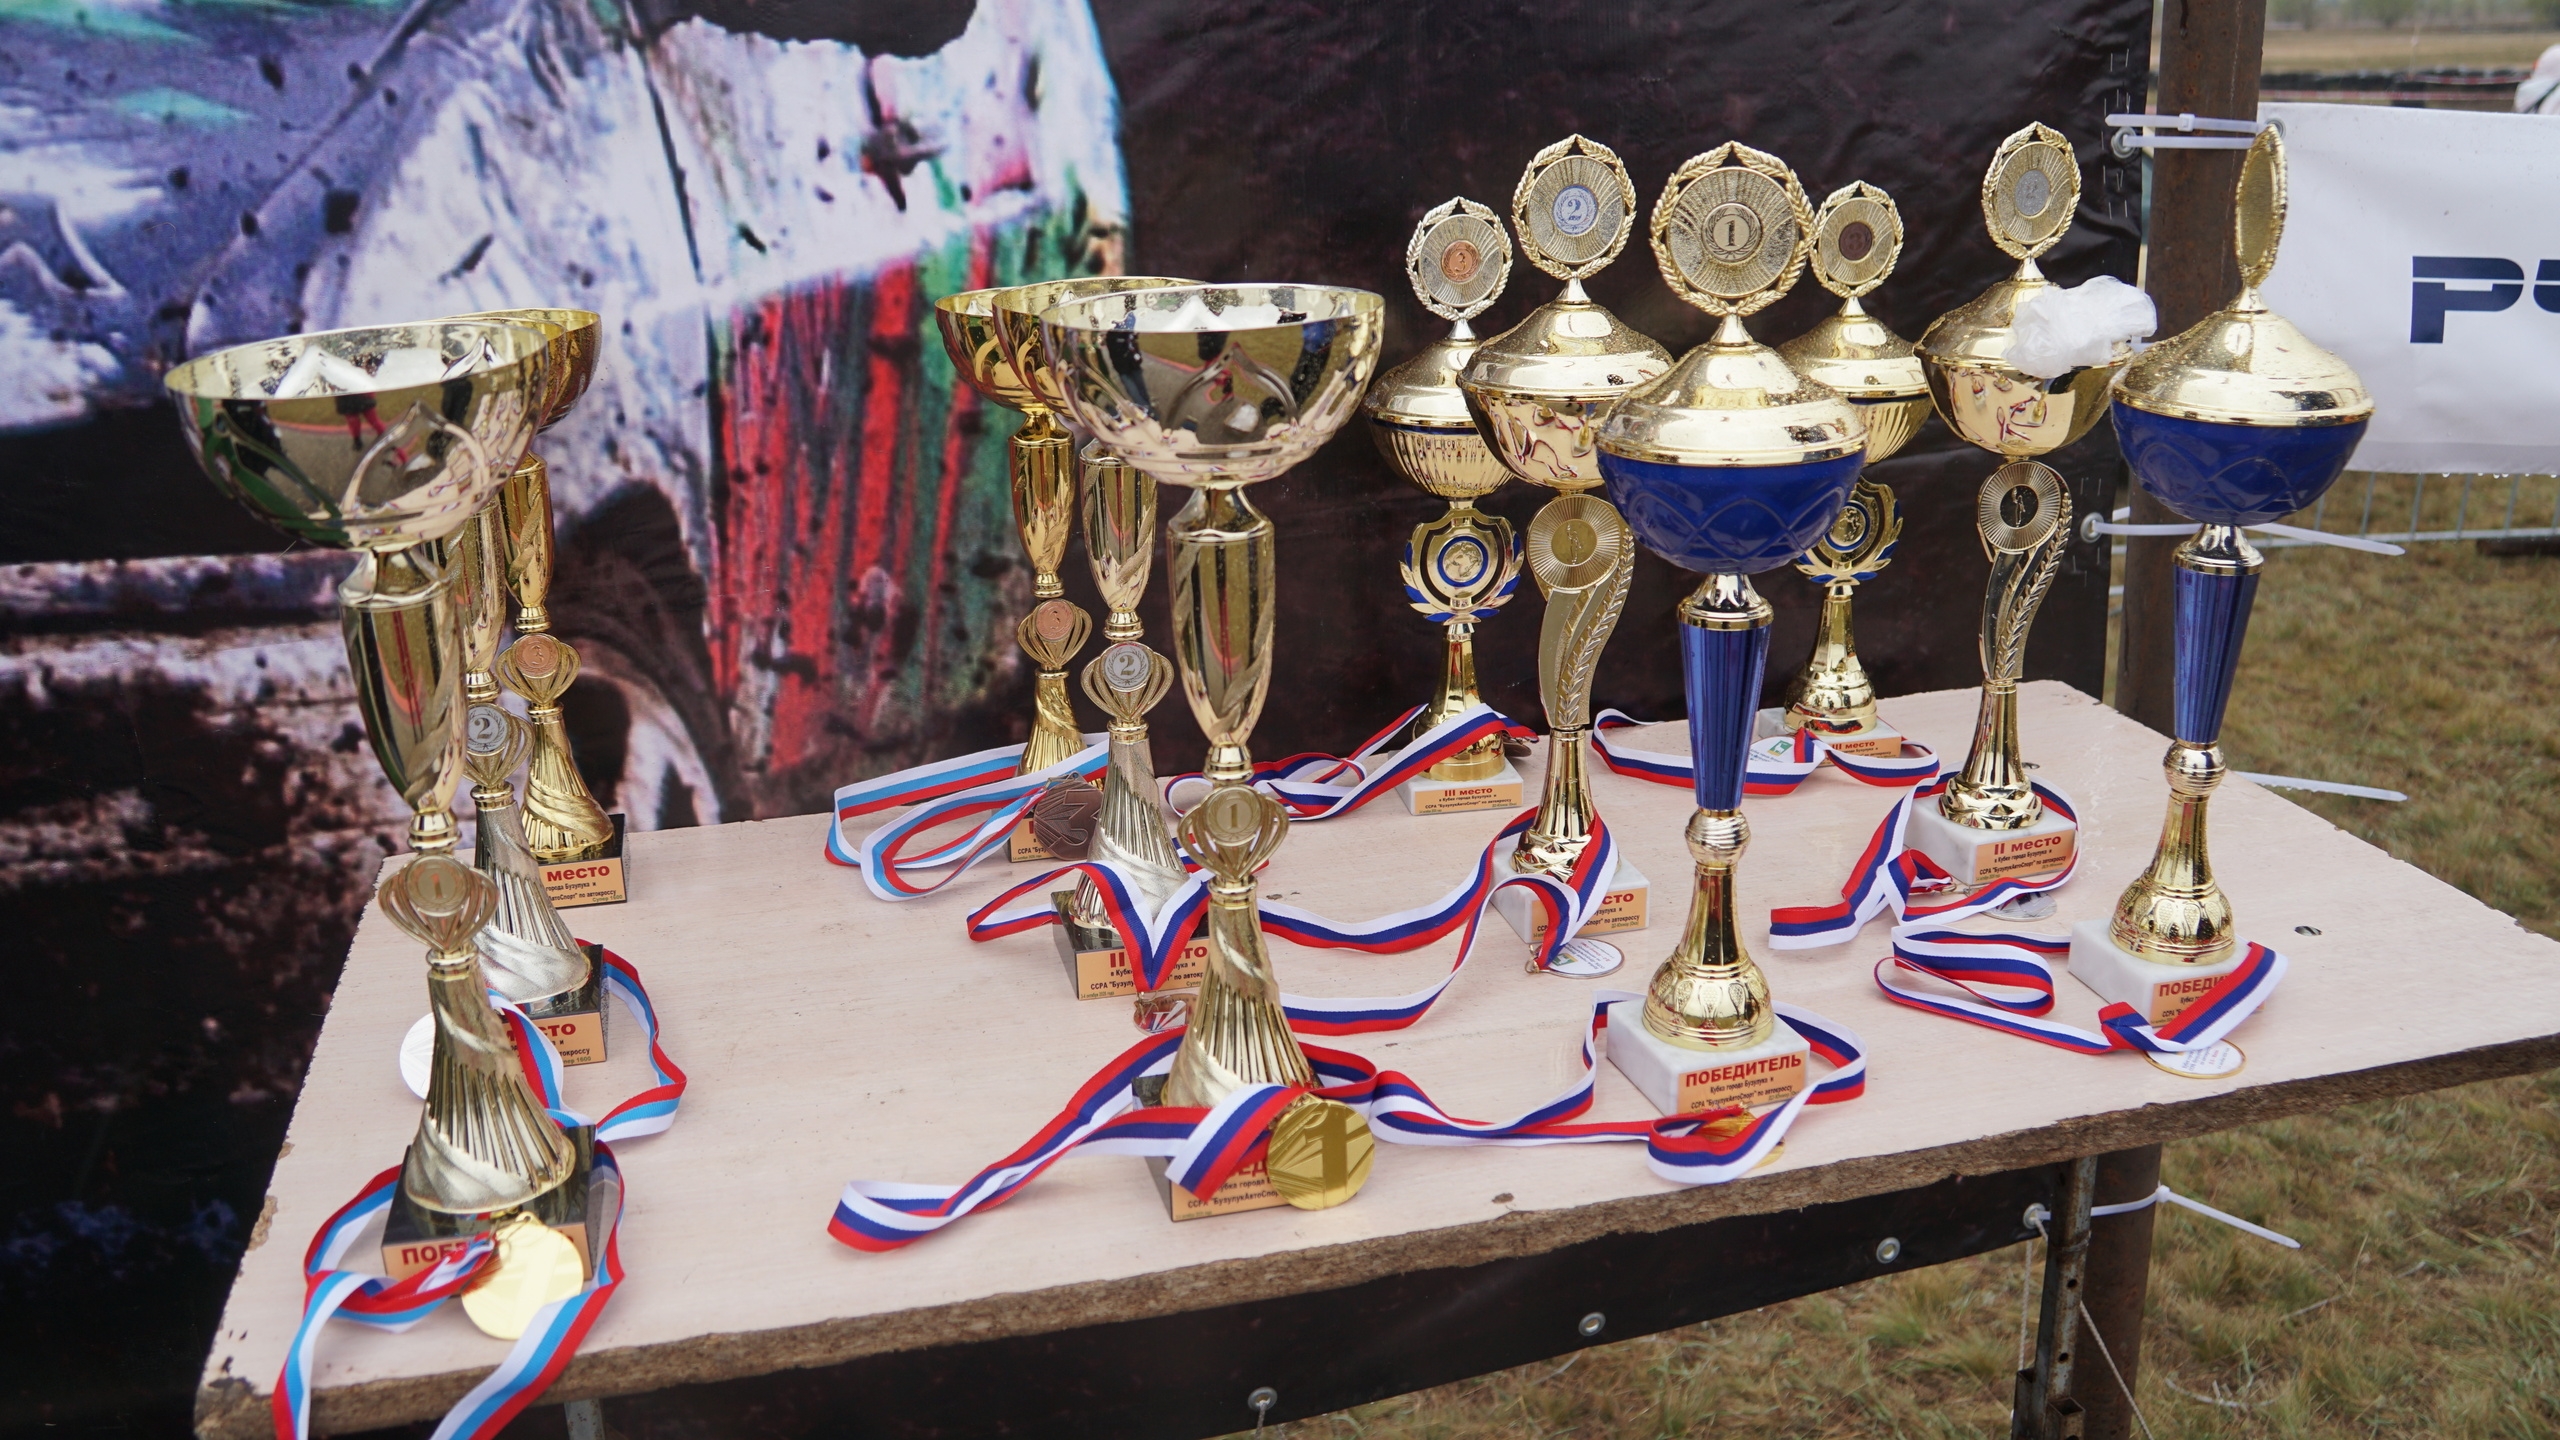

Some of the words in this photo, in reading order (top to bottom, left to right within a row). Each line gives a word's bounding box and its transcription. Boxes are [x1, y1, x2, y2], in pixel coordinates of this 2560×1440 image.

[1567, 199, 1581, 221] 2
[1725, 219, 1736, 248] 1
[1454, 251, 1466, 272] 3
[1120, 655, 1135, 676] 2
[474, 716, 492, 739] 2
[1226, 803, 1238, 829] 1
[1994, 843, 2004, 855] II
[2011, 836, 2062, 852] место
[547, 866, 610, 882] место
[1602, 893, 1634, 905] сто
[1110, 952, 1125, 968] II
[559, 1048, 590, 1057] токроссу
[1686, 1055, 1801, 1087] ПОБЕДИТЕЛЬ
